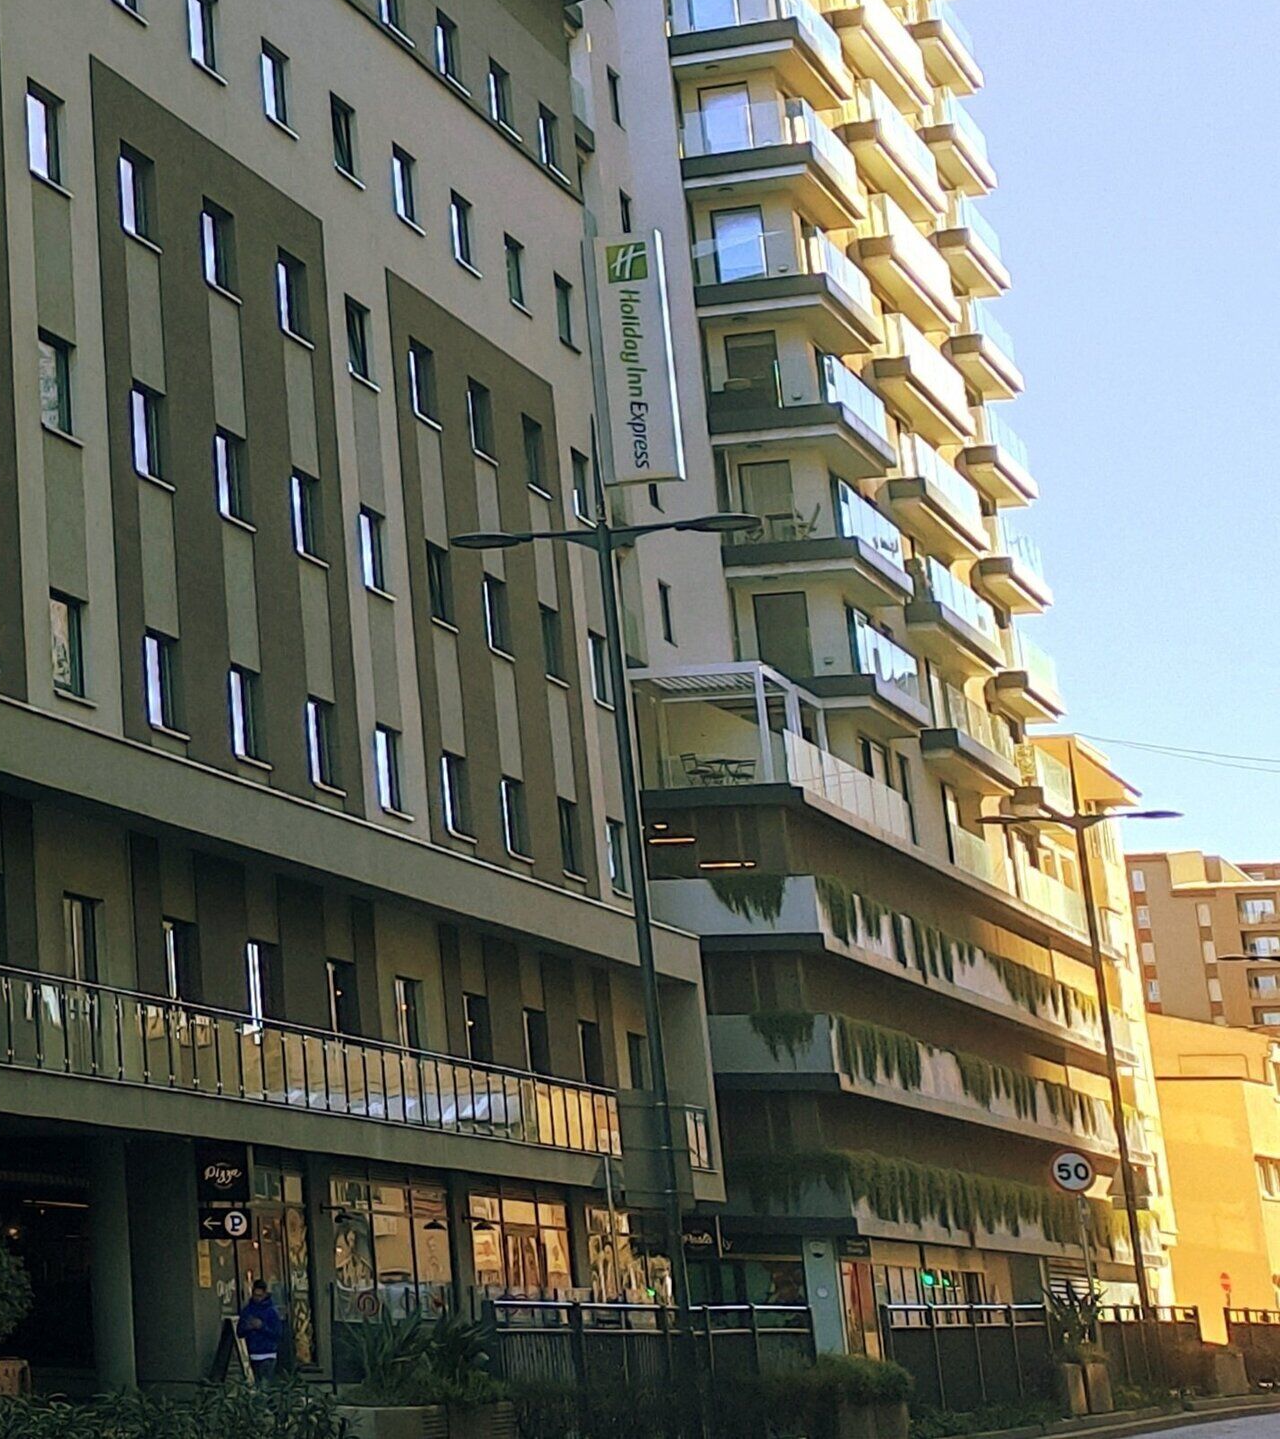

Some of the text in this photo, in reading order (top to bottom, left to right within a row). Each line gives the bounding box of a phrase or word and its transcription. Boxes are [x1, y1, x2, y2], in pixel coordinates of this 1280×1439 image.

[619, 289, 650, 470] Holiday Inn Express
[204, 1166, 242, 1183] Pizza
[1057, 1163, 1089, 1181] 50
[229, 1215, 243, 1232] P
